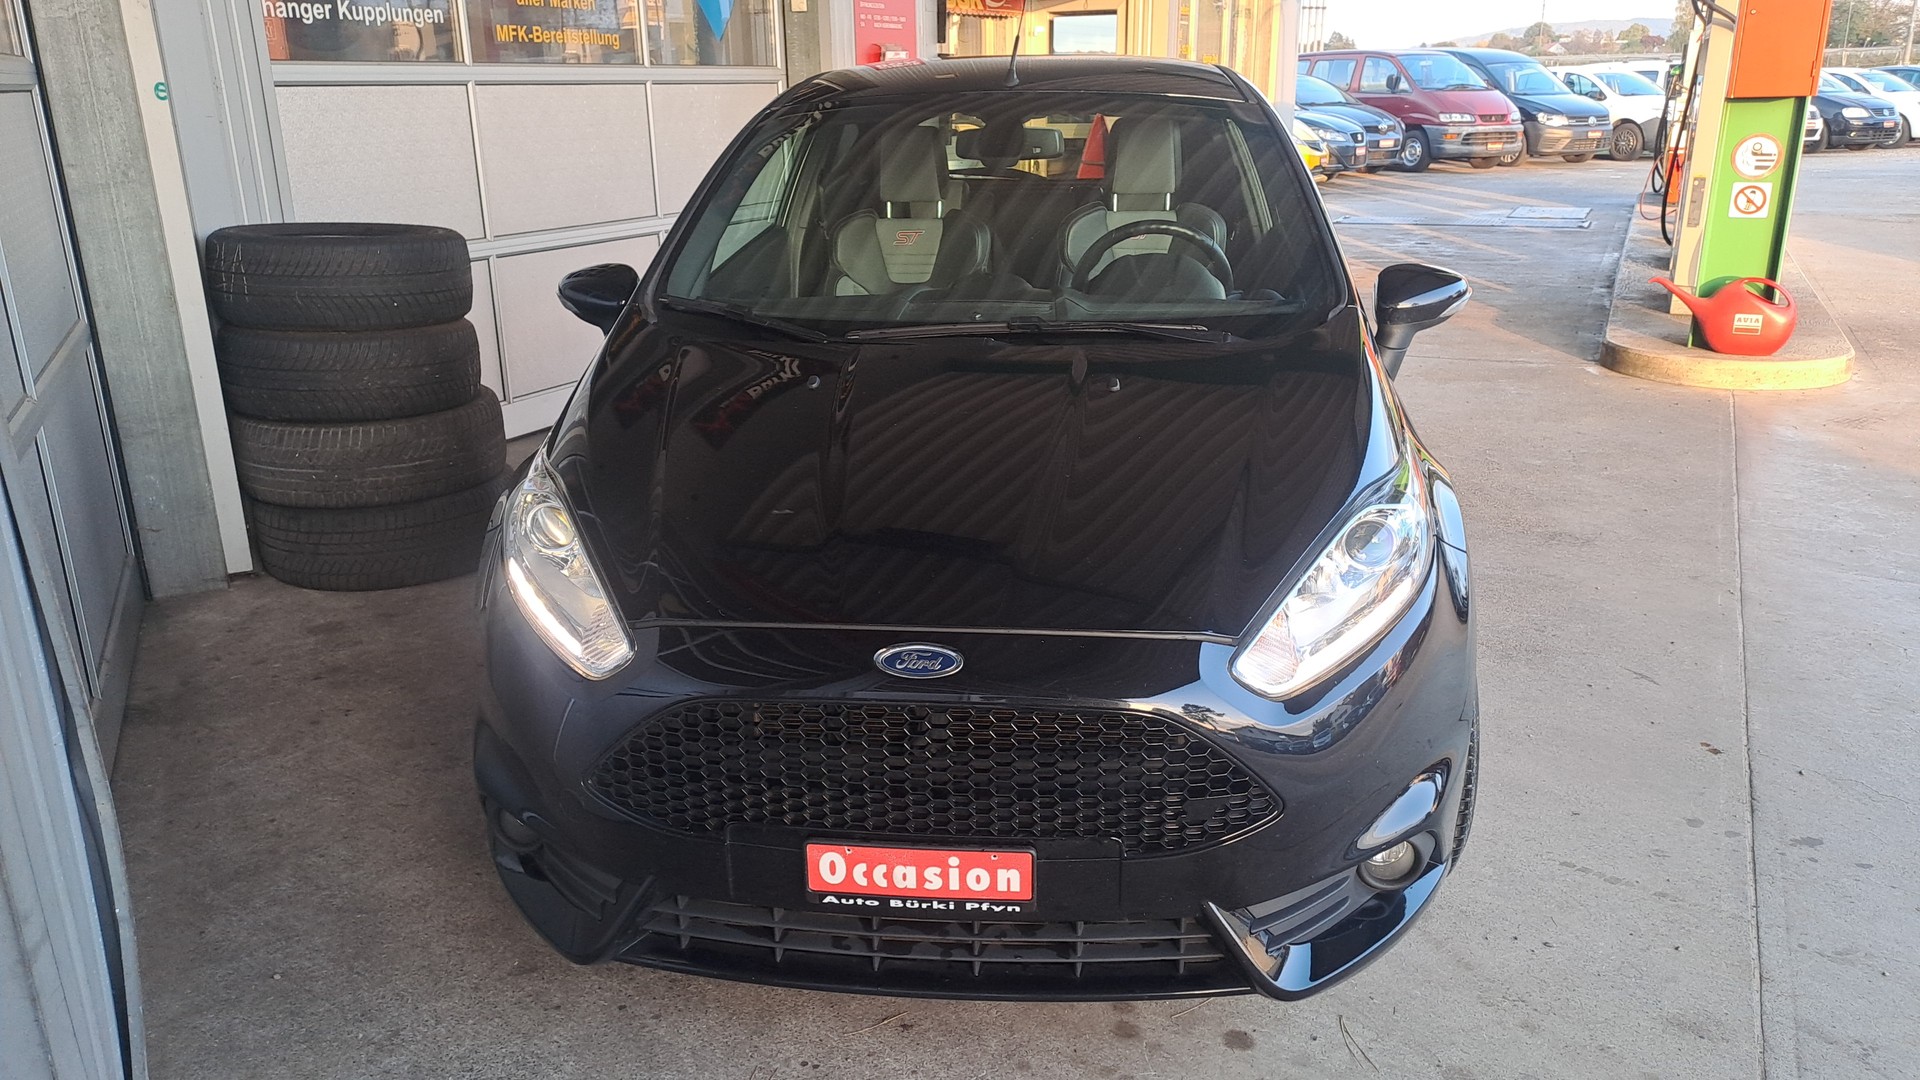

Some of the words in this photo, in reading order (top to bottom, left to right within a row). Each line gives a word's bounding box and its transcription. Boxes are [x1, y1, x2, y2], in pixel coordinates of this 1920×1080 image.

[337, 0, 444, 27] Kupplungen
[496, 24, 620, 49] MFK-Bereitstellung
[893, 230, 925, 246] ST
[1736, 316, 1760, 324] AVIA
[896, 651, 943, 670] Ford
[819, 852, 1021, 892] Occasion
[822, 895, 880, 907] Auto
[889, 899, 955, 910] Bürki
[965, 902, 1021, 912] Pfyn
